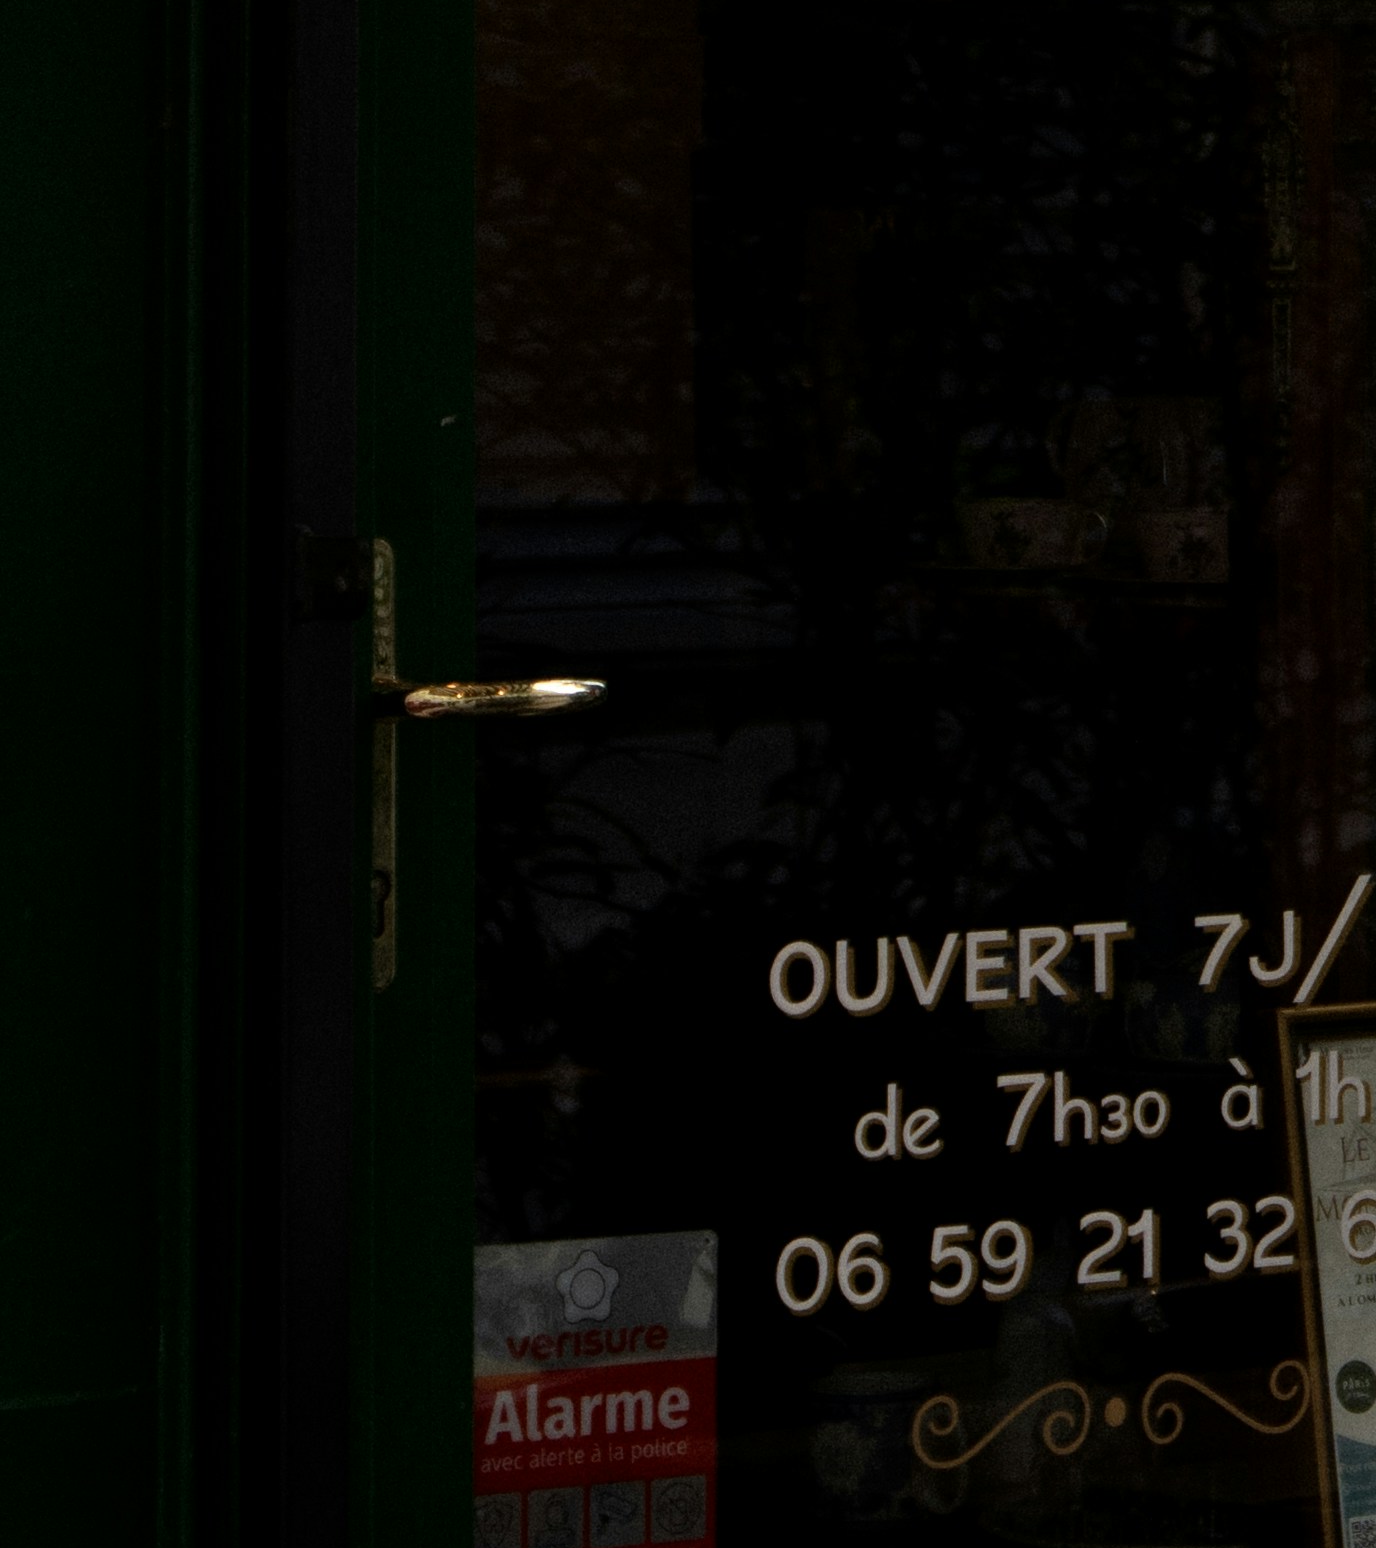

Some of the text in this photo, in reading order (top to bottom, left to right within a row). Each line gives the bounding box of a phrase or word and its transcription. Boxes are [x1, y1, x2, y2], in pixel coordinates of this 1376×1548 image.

[769, 920, 1135, 1017] OUVERT
[854, 1050, 1371, 1160] de 7h30 à 1h
[1340, 1135, 1370, 1164] LE
[776, 1232, 891, 1316] 06
[929, 1219, 1034, 1303] 59
[1077, 1208, 1160, 1288] 21
[1203, 1195, 1298, 1279] 32
[505, 1322, 669, 1363] verisure
[484, 1382, 691, 1447] Alarme
[480, 1437, 688, 1475] avec alerte à la police
